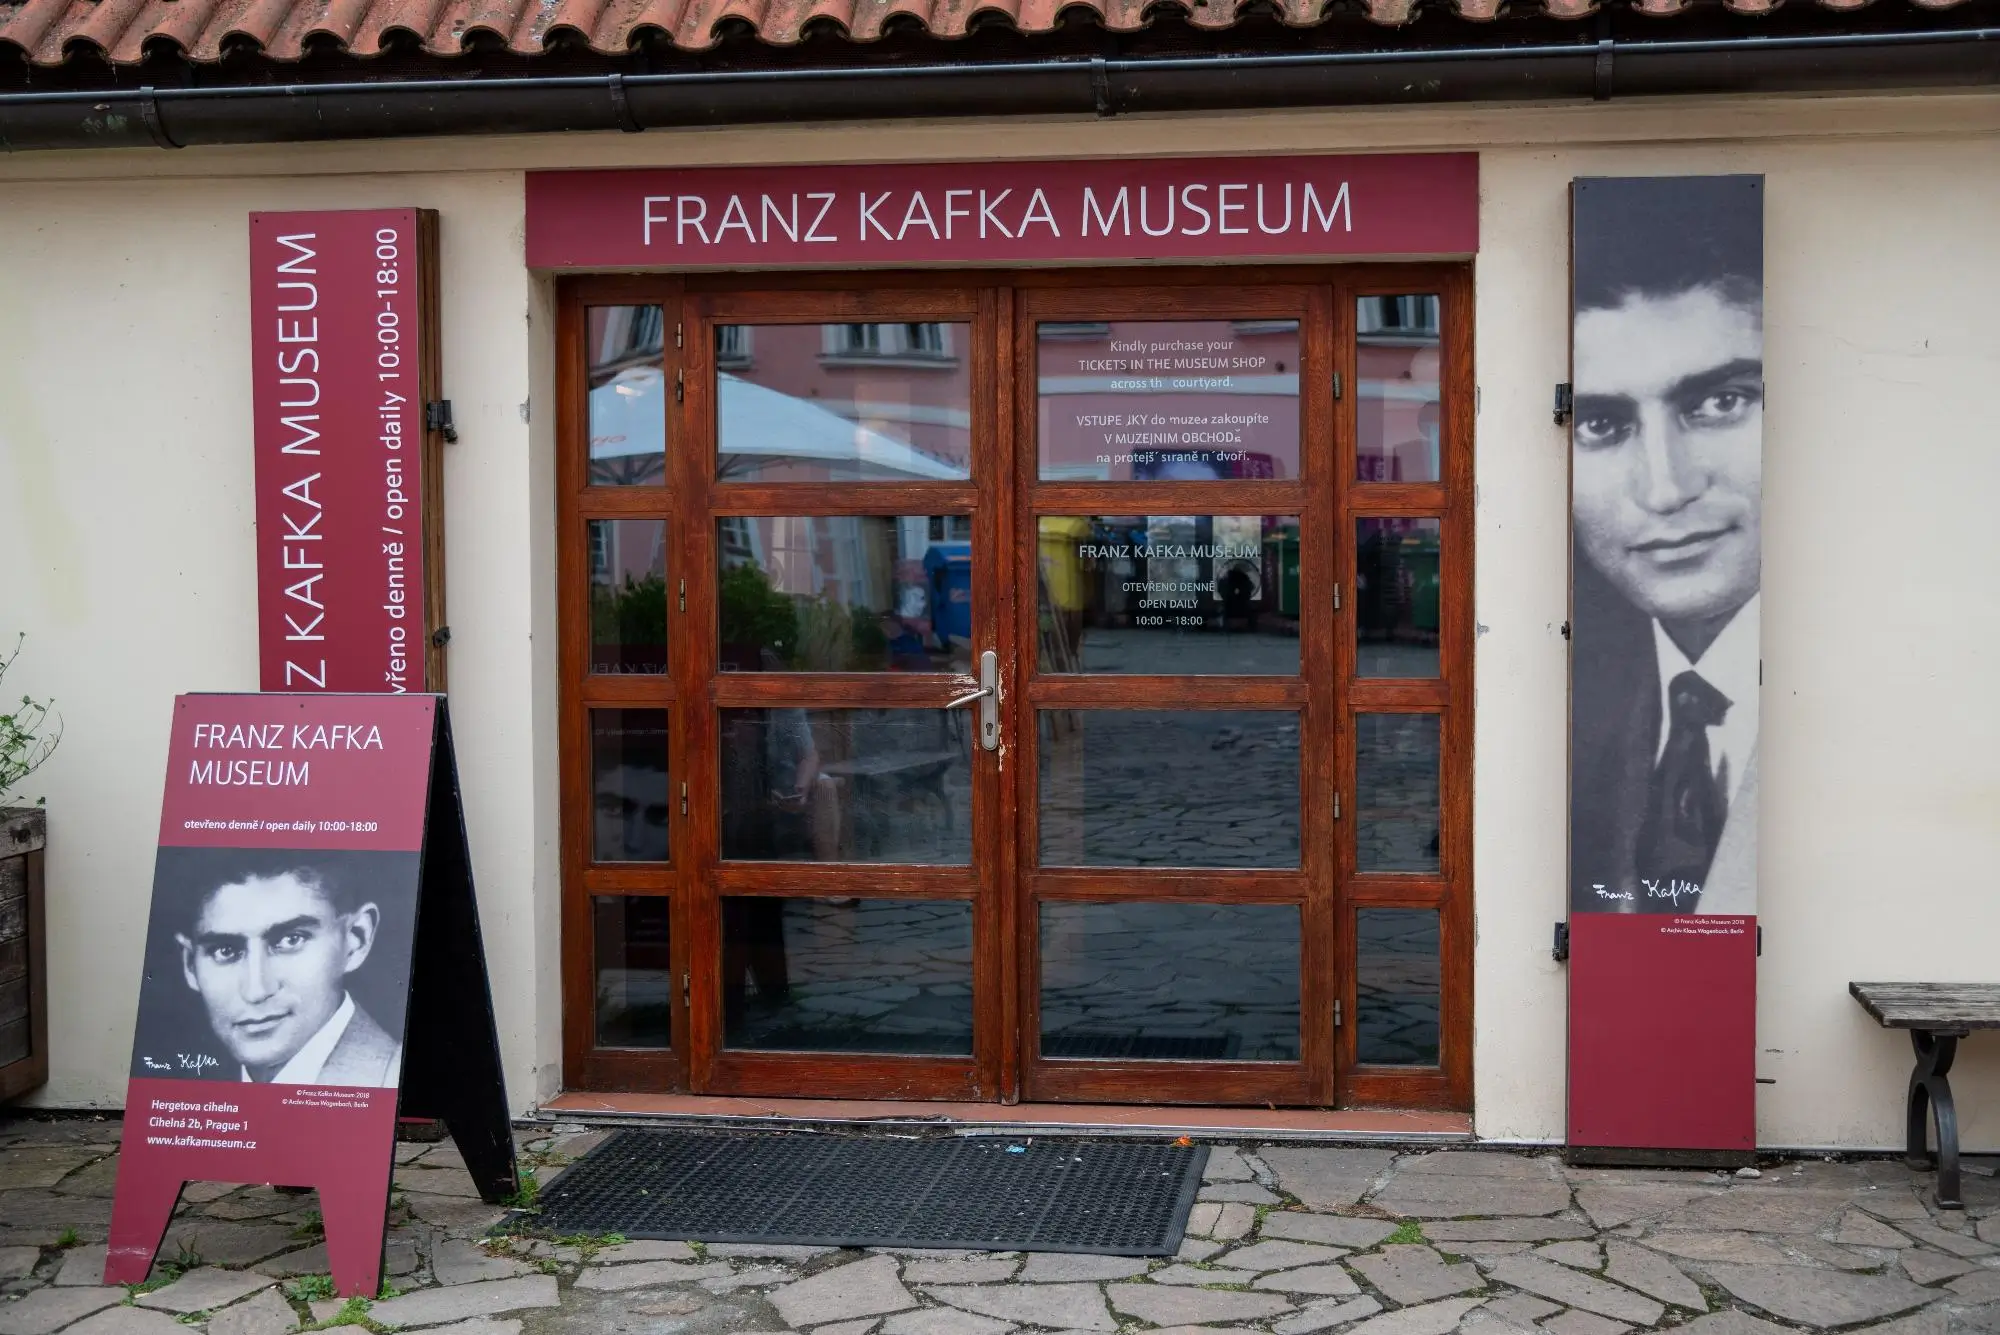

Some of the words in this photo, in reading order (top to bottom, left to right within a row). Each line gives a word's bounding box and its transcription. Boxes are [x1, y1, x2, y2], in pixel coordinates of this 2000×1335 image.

[641, 192, 838, 246] FRANZ
[858, 188, 1062, 242] KAFKA
[1080, 181, 1353, 238] MUSEUM
[375, 227, 400, 382] 10:00-18:00
[276, 232, 321, 456] MUSEUM
[1110, 340, 1147, 353] Kindly
[1151, 340, 1203, 353] purchase
[1207, 341, 1233, 353] your
[1078, 359, 1127, 371] TICKETS
[1130, 359, 1143, 370] IN
[1147, 358, 1171, 369] THE
[1174, 357, 1229, 369] MUSEUM
[1232, 356, 1266, 368] SHOP
[1110, 379, 1146, 389] across
[1149, 377, 1163, 388] th
[1172, 376, 1233, 390] courtyard.
[379, 390, 407, 452] daily
[1150, 413, 1166, 425] do
[1104, 433, 1113, 444] V
[1096, 454, 1111, 463] na
[384, 458, 408, 520] open
[382, 527, 403, 535] /
[282, 471, 325, 642] KAFKA
[1079, 545, 1130, 559] FRANZ
[1134, 545, 1186, 558] KAFKA
[1191, 545, 1259, 558] MUSEUM
[383, 544, 406, 618] denně
[1122, 580, 1177, 592] OTEVŘENO
[1179, 580, 1216, 592] DENNĚ
[1139, 600, 1167, 609] OPEN
[1169, 599, 1198, 609] DAILY
[1135, 616, 1163, 626] 10:00
[1175, 616, 1203, 626] 18:00
[194, 724, 285, 749] FRANZ
[292, 725, 384, 750] KAFKA
[189, 760, 310, 785] MUSEUM
[184, 819, 226, 830] otevřeno
[228, 820, 258, 830] denně
[266, 822, 290, 833] open
[292, 821, 316, 833] daily
[319, 821, 378, 832] 10:00-18:00
[1593, 884, 1635, 900] Franz
[1641, 879, 1703, 907] Kafka
[144, 1056, 172, 1070] Franz
[178, 1053, 219, 1076] Kafka
[151, 1100, 201, 1114] Hergetova
[203, 1102, 239, 1113] cihelna
[149, 1117, 186, 1128] Cihelná
[188, 1118, 203, 1130] 2b,
[205, 1119, 241, 1133] Prague
[243, 1121, 248, 1131] 1
[147, 1135, 257, 1150] www.kafkamuseum.cz
